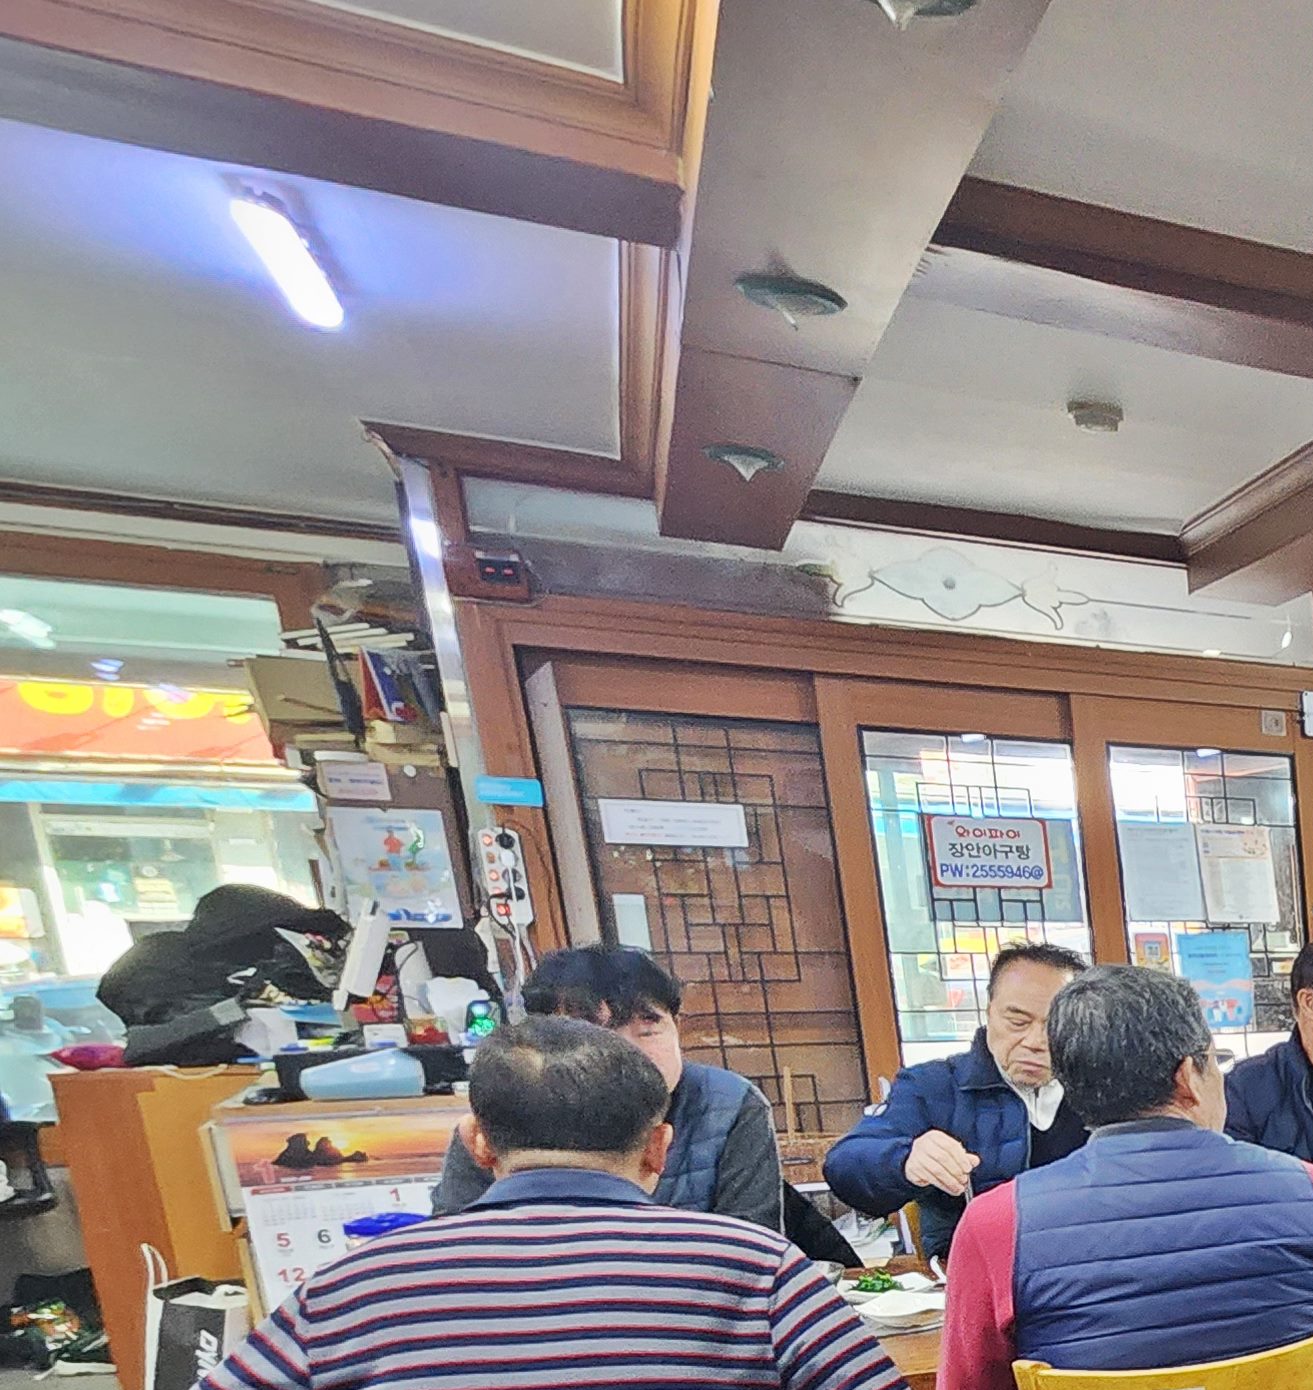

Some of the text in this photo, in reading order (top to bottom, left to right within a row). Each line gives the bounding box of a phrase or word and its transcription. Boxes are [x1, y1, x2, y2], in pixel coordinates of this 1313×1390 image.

[955, 825, 1020, 839] 와이파이
[948, 842, 1031, 860] 장안아구탕
[940, 863, 1044, 880] PW:2555946@
[389, 1188, 401, 1202] 1
[276, 1229, 331, 1247] 5 6
[277, 1267, 305, 1284] 12
